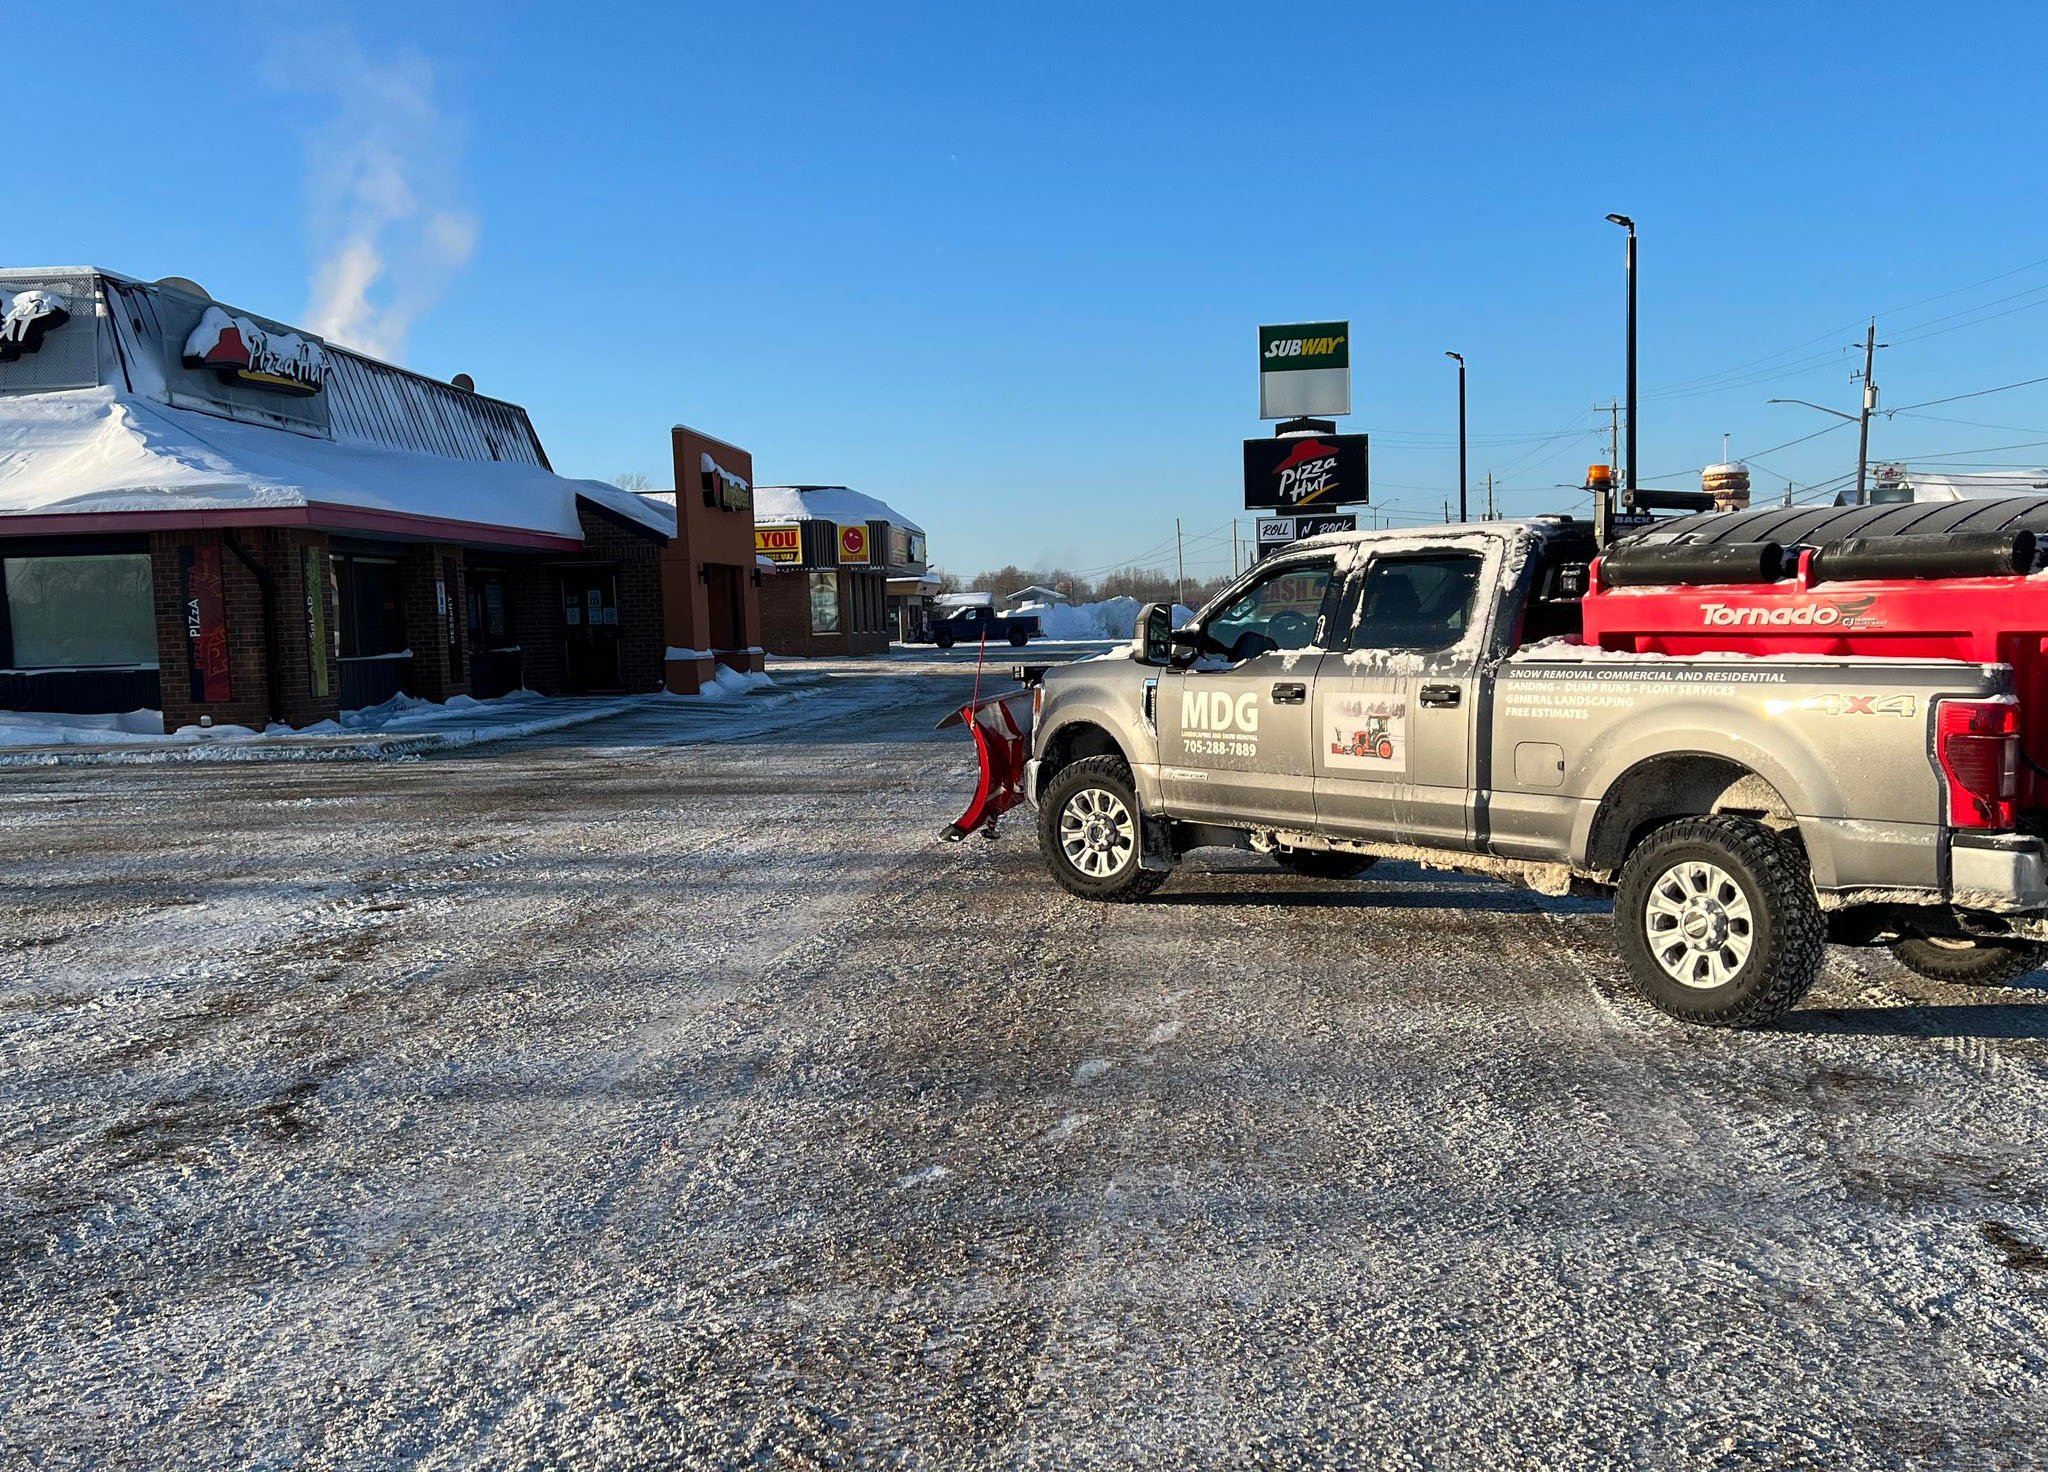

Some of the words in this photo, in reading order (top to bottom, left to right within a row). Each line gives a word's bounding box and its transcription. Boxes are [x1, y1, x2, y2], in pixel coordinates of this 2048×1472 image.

[1264, 336, 1345, 358] SUBWAY
[247, 333, 296, 378] Pizza
[295, 341, 331, 385] Hut
[1279, 457, 1337, 497] Pizza
[1289, 472, 1333, 502] Hut
[1614, 515, 1651, 524] BACK
[1262, 522, 1289, 537] ROLL
[1301, 520, 1313, 538] N
[760, 532, 797, 547] YOU
[1700, 603, 1839, 625] Tornado
[1842, 616, 1855, 627] CJ
[1509, 669, 1541, 678] SNOW
[1543, 670, 1594, 680] REMOVAL
[1596, 671, 1673, 681] COMMERCIAL
[1675, 671, 1703, 681] AND
[1707, 672, 1786, 683] RESIDENTIAL
[1507, 682, 1555, 692] SANDING
[1564, 683, 1599, 693] DUMP
[1600, 684, 1632, 694] RUNS
[1639, 684, 1678, 694] FLOAT
[1679, 685, 1736, 696] SERVICES
[1505, 694, 1553, 705] GENERAL
[1554, 695, 1635, 707] LANDSCAPING
[1181, 690, 1259, 732] MDG
[1505, 706, 1530, 717] FREE
[1531, 707, 1589, 719] ESTIMATES
[1183, 739, 1257, 757] 705-288-7889
